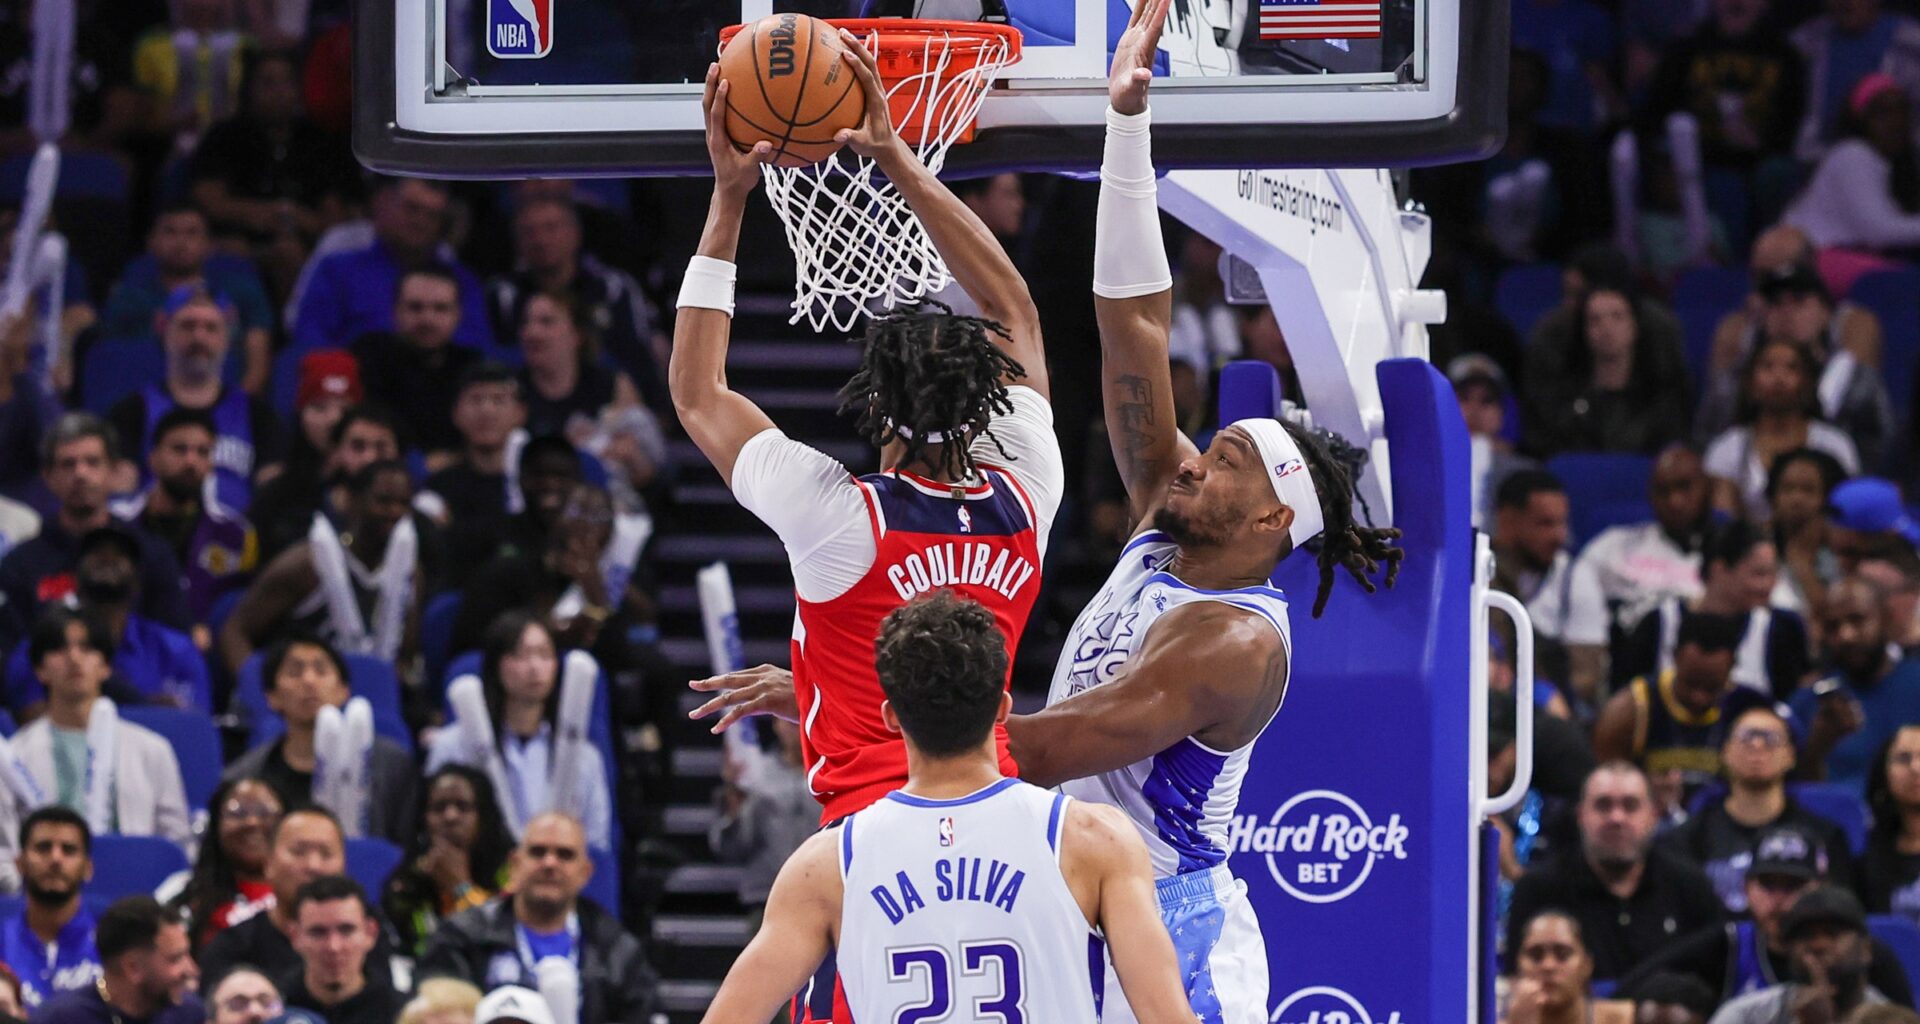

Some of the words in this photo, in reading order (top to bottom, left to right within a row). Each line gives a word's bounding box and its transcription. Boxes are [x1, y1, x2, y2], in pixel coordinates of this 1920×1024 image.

[497, 23, 527, 48] NBA
[769, 11, 798, 80] Wilso
[887, 542, 1035, 601] COULIBALY
[1229, 814, 1320, 852] Hard
[1321, 814, 1409, 860] Rock
[870, 870, 925, 926] DA
[935, 857, 1026, 914] SILVA
[1298, 863, 1343, 883] BET
[884, 937, 1030, 1024] 23
